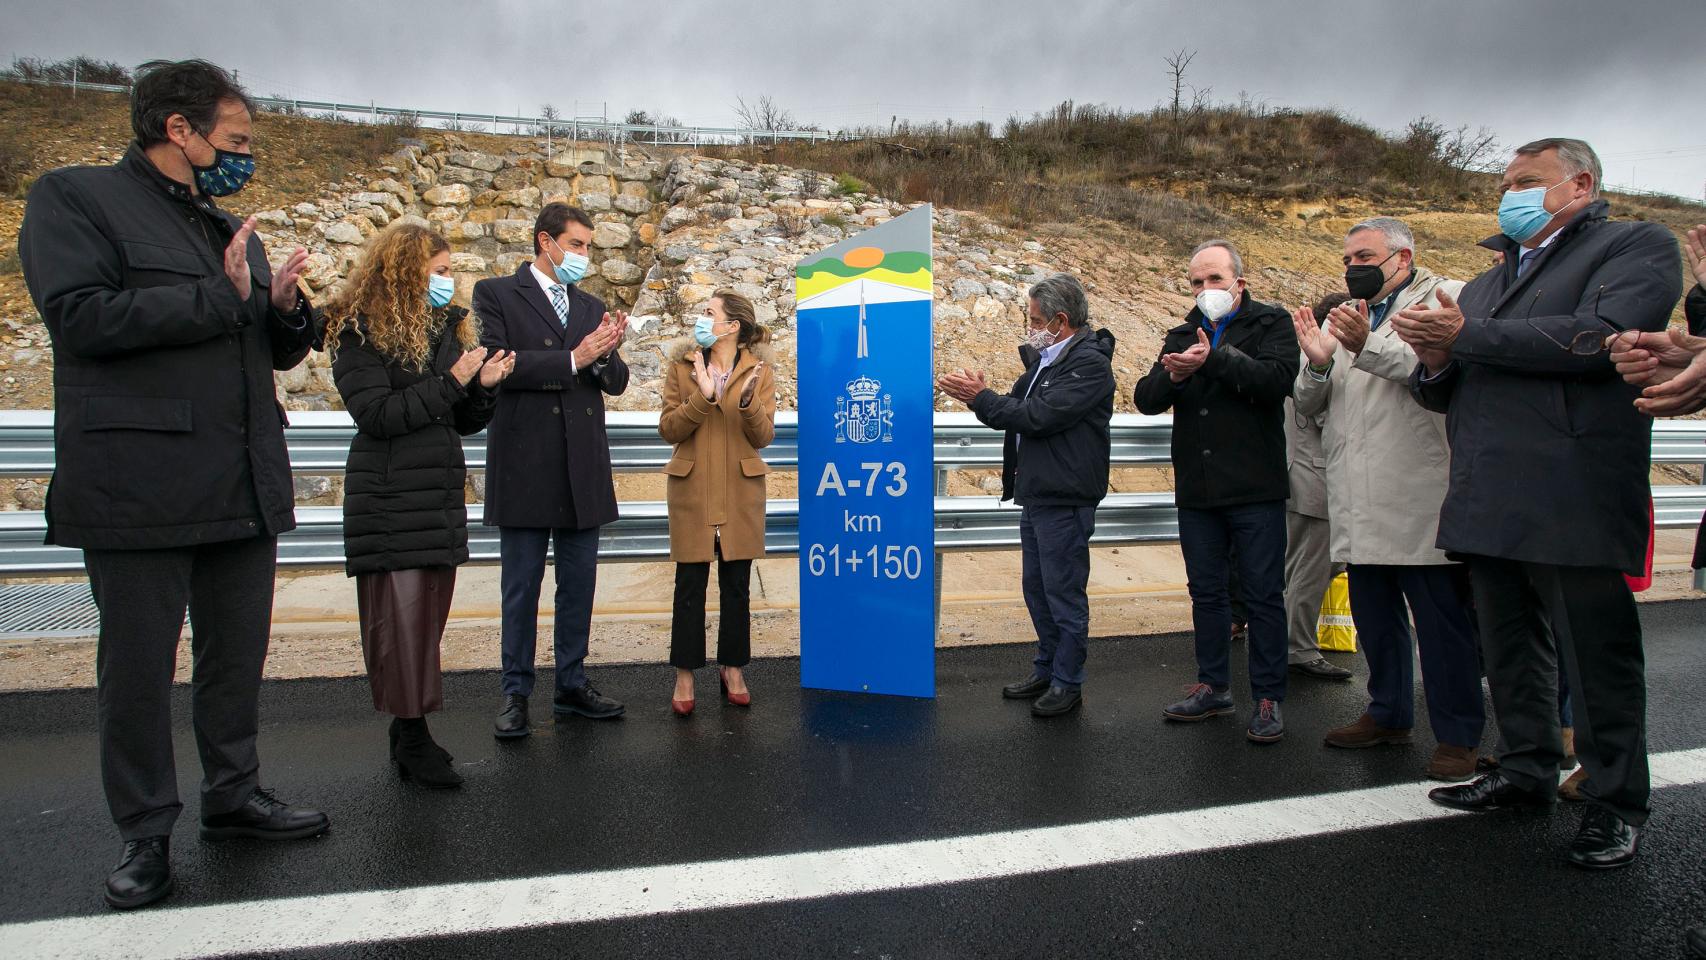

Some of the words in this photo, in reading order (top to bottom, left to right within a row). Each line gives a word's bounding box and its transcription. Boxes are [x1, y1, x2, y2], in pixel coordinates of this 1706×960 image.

[815, 461, 908, 497] A-73
[844, 509, 881, 532] km
[808, 543, 922, 580] 61+150
